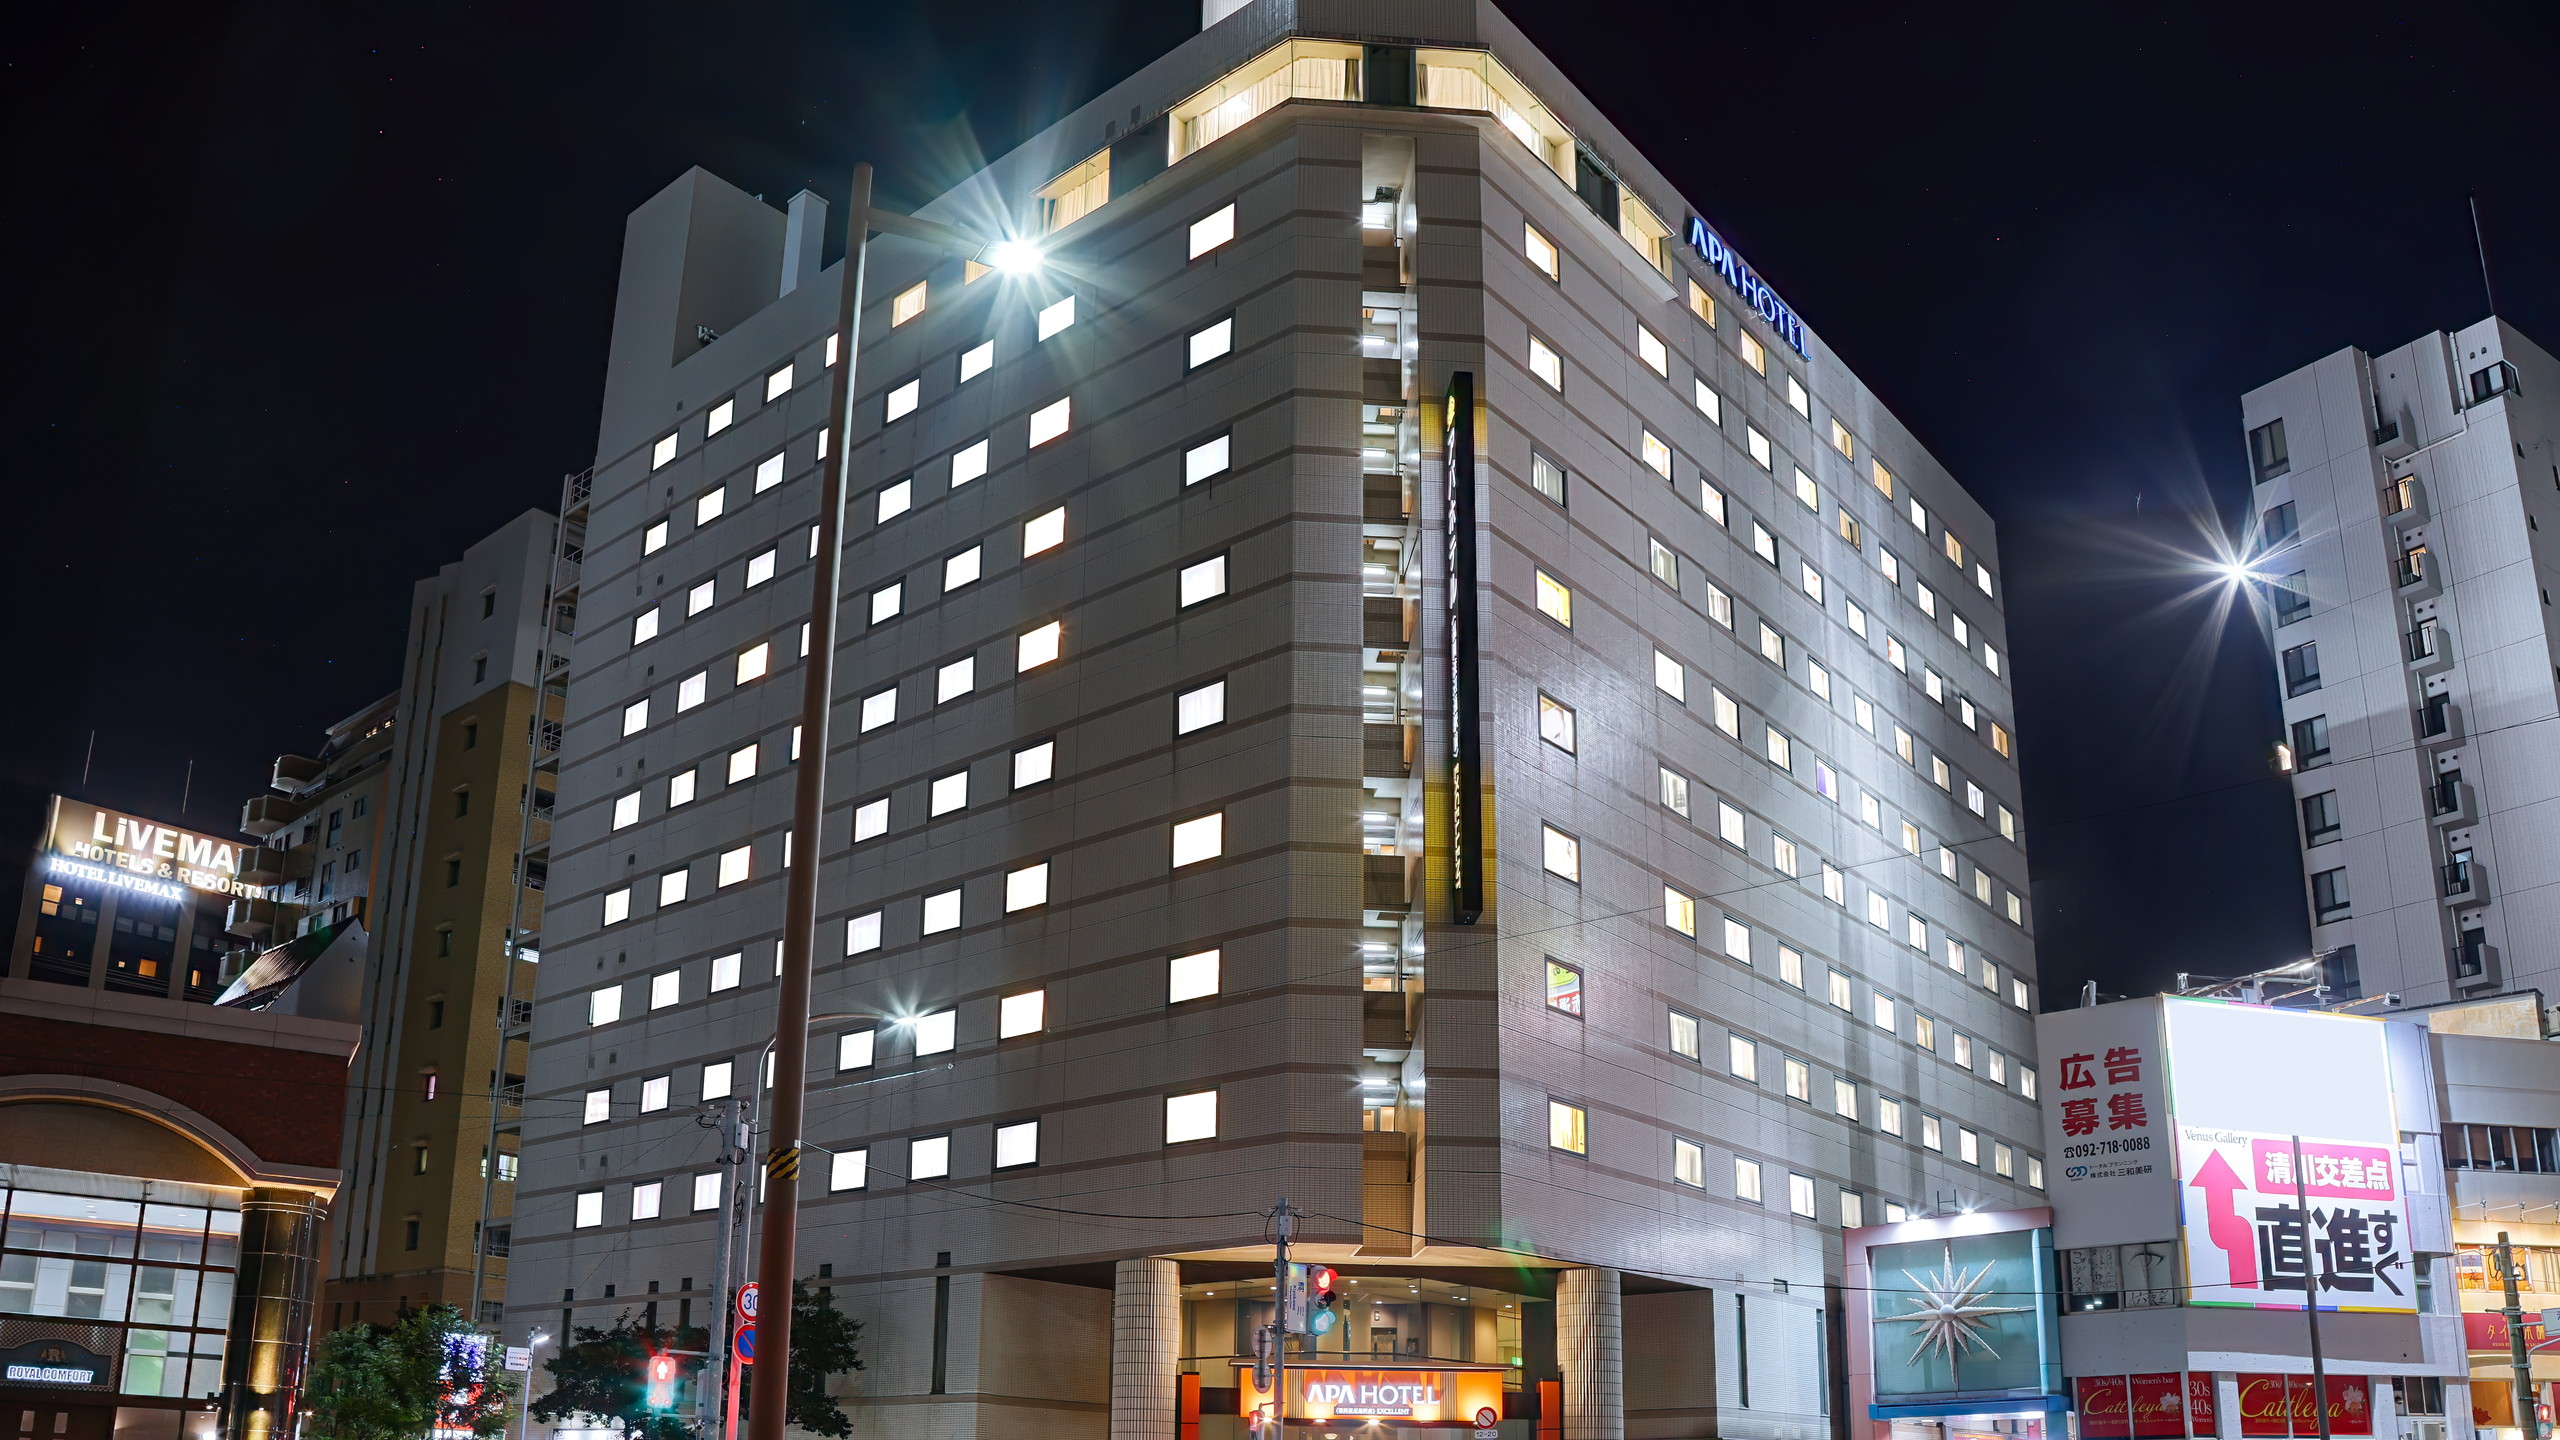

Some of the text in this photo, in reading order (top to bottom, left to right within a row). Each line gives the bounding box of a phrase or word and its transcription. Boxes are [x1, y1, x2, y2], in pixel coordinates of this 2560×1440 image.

[1691, 217, 1811, 361] APA HOTEL
[93, 811, 243, 874] LiVEMA
[50, 857, 107, 883] HOTEL
[74, 840, 154, 874] HOTELS
[157, 862, 173, 880] &
[2060, 1046, 2142, 1091] 広告
[2061, 1092, 2148, 1137] 募集
[2075, 1136, 2151, 1158] 092-718-0088
[2184, 1129, 2248, 1148] Venus Gallery
[2265, 1151, 2391, 1191] 清川交差点
[2255, 1203, 2404, 1297] 直進 すぐ
[7, 1366, 93, 1383] ROYAL COMFORT
[2189, 1380, 2211, 1397] 30s
[1307, 1384, 1440, 1405] APA HOTEL
[2191, 1399, 2213, 1415] 40s
